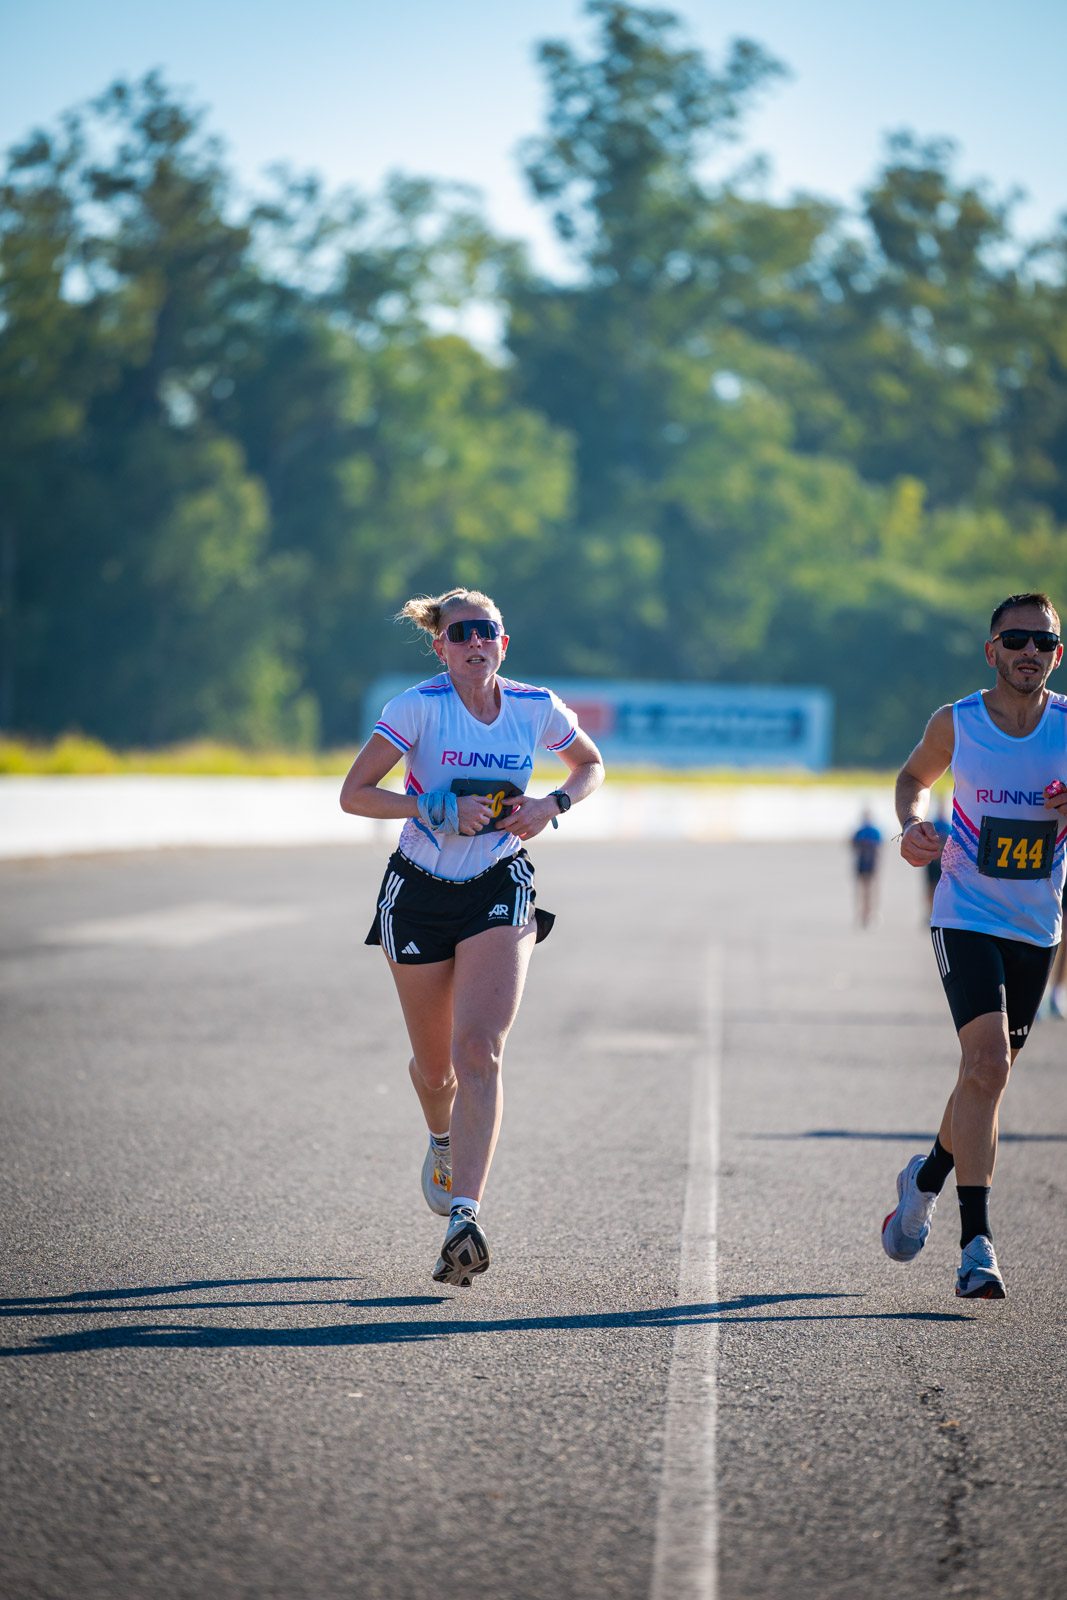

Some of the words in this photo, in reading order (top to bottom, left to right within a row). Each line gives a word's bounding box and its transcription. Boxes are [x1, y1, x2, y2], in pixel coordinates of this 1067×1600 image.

[441, 750, 533, 770] RUNNEA
[976, 789, 1044, 806] RUNNE
[997, 837, 1043, 869] 744
